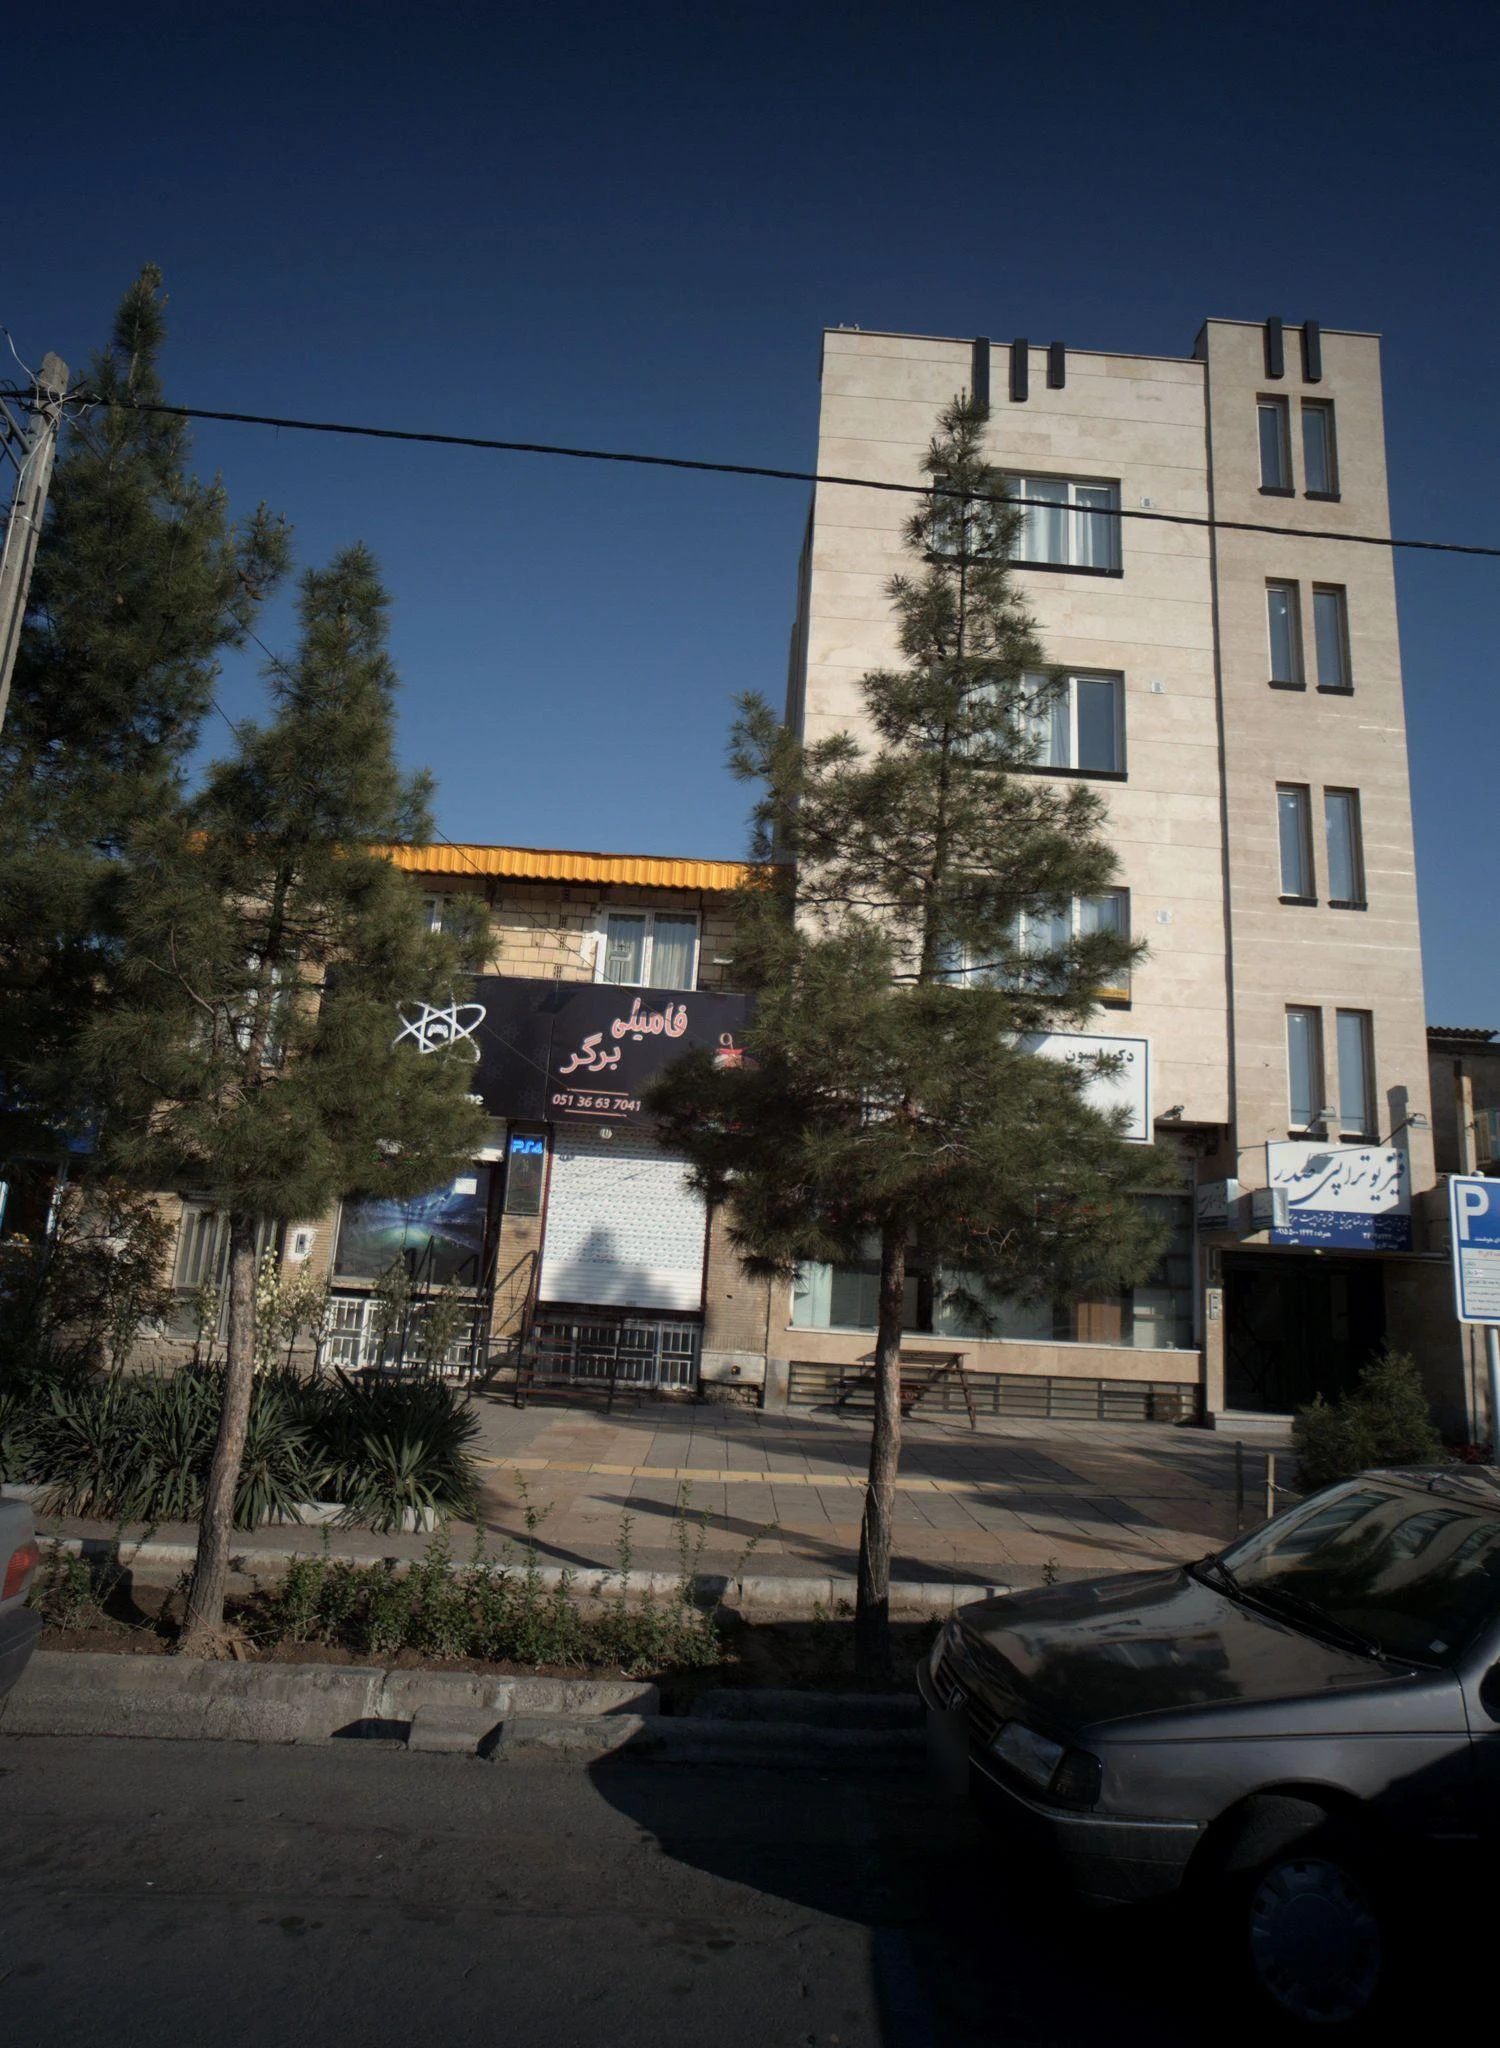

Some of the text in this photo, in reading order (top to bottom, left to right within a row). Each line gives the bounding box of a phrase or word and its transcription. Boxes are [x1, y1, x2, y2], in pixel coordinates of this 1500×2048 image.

[611, 997, 688, 1041] فامیلی
[559, 1034, 622, 1075] برگر
[552, 1093, 642, 1112] 051 36 63 7041
[511, 1138, 544, 1155] PS4
[1287, 1152, 1406, 1207] فیزیوتراپی
[1456, 1183, 1490, 1241] P
